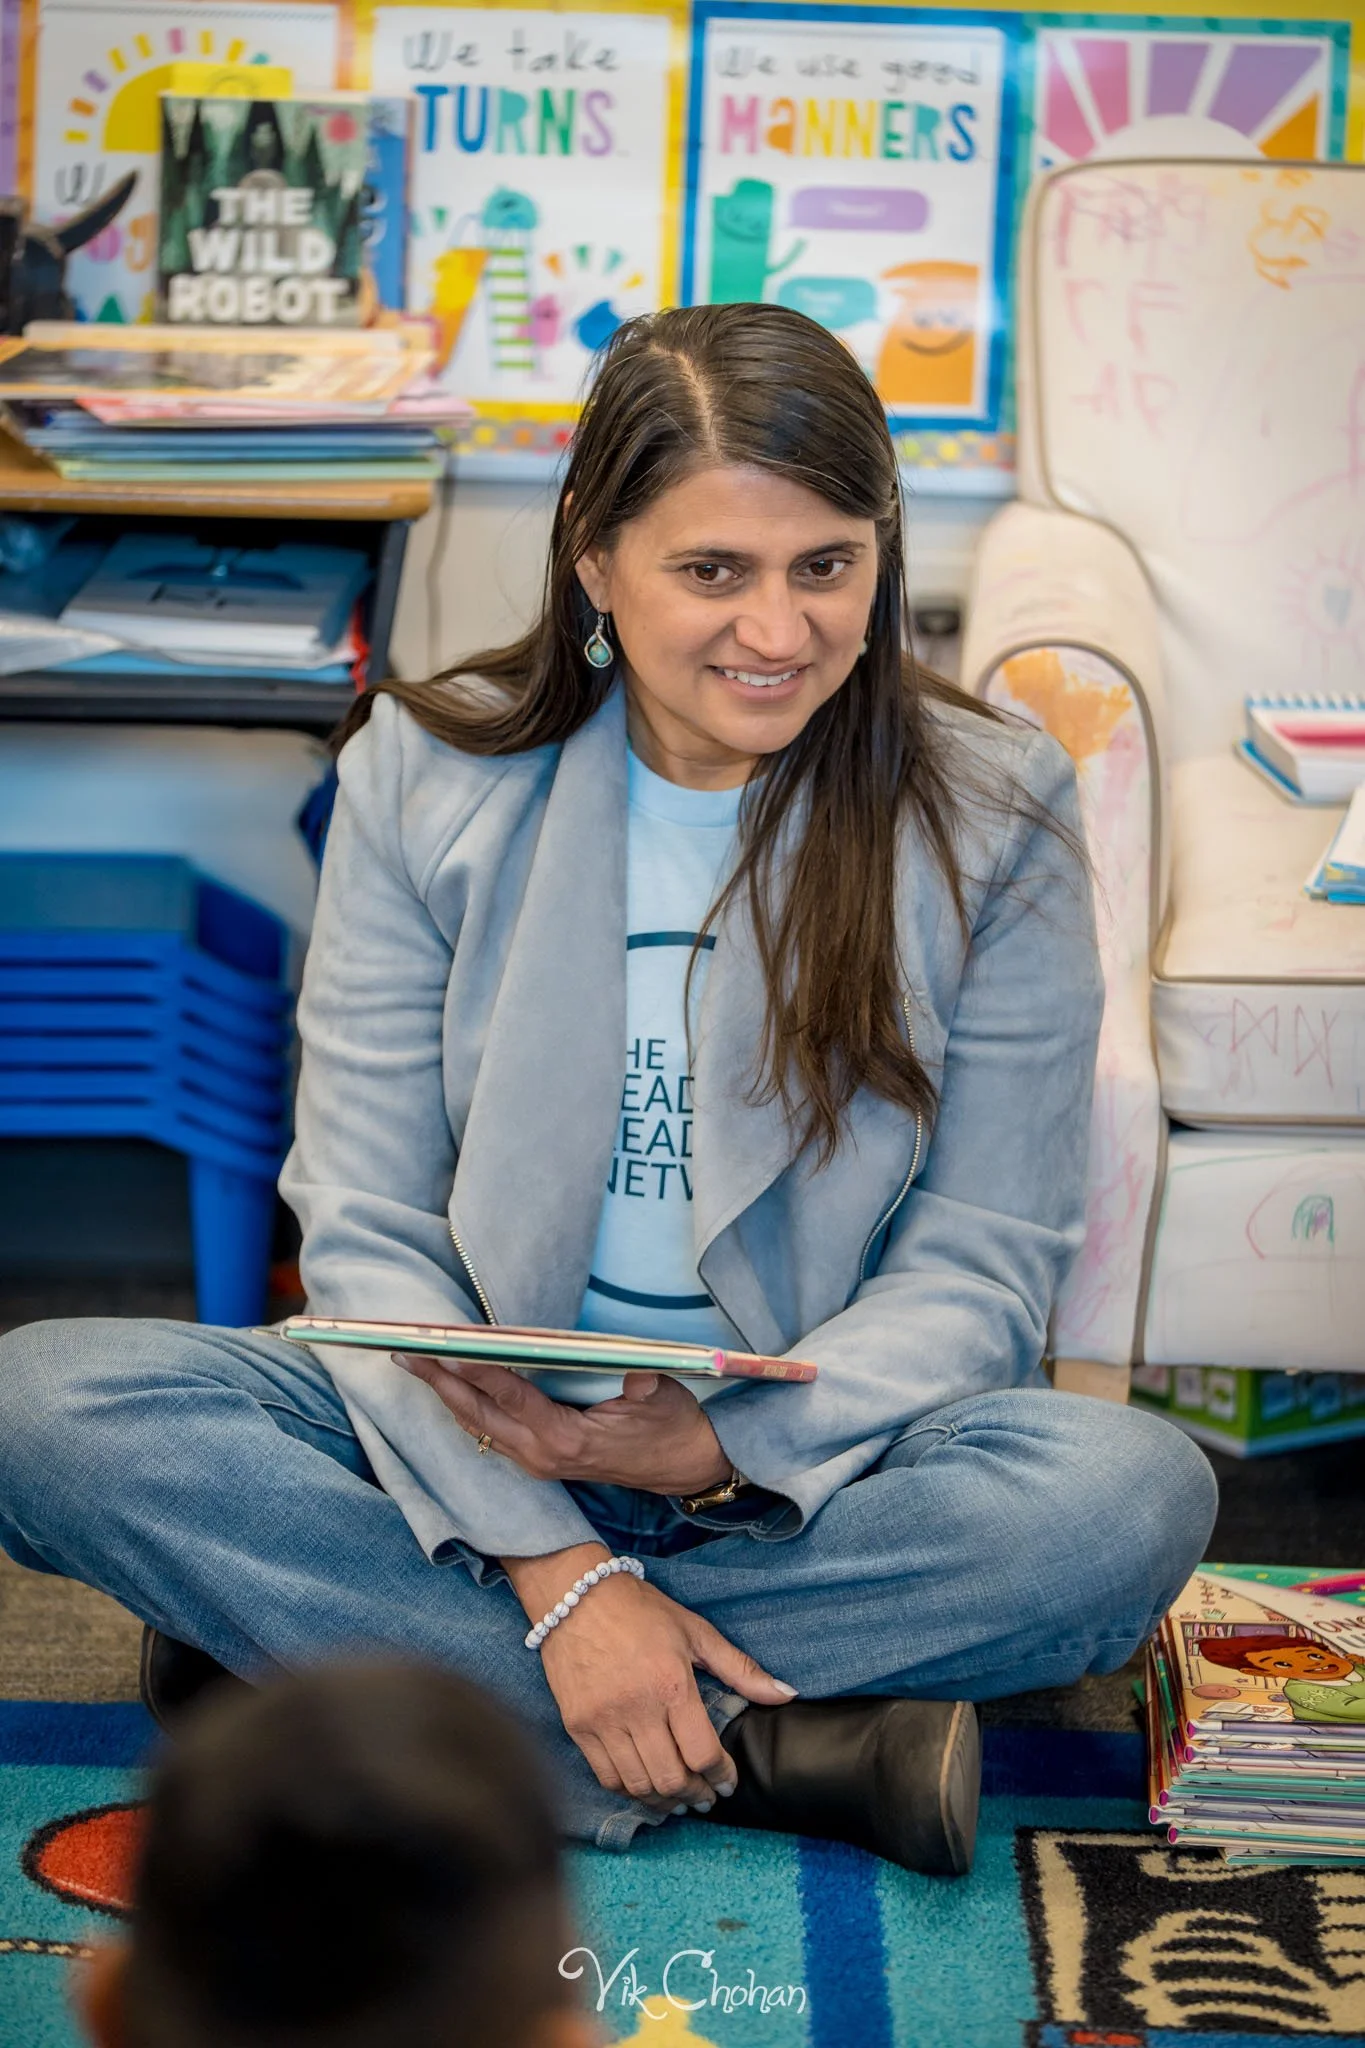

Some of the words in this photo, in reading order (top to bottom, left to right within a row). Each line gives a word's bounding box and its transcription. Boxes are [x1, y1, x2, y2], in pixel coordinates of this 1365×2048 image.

[403, 30, 478, 72] We
[505, 28, 619, 72] take
[716, 48, 777, 79] We
[797, 54, 860, 79] use
[881, 48, 981, 94] good
[413, 84, 614, 157] TURNS
[210, 187, 315, 225] THE
[188, 228, 336, 273] WILD
[168, 273, 350, 324] ROBOT
